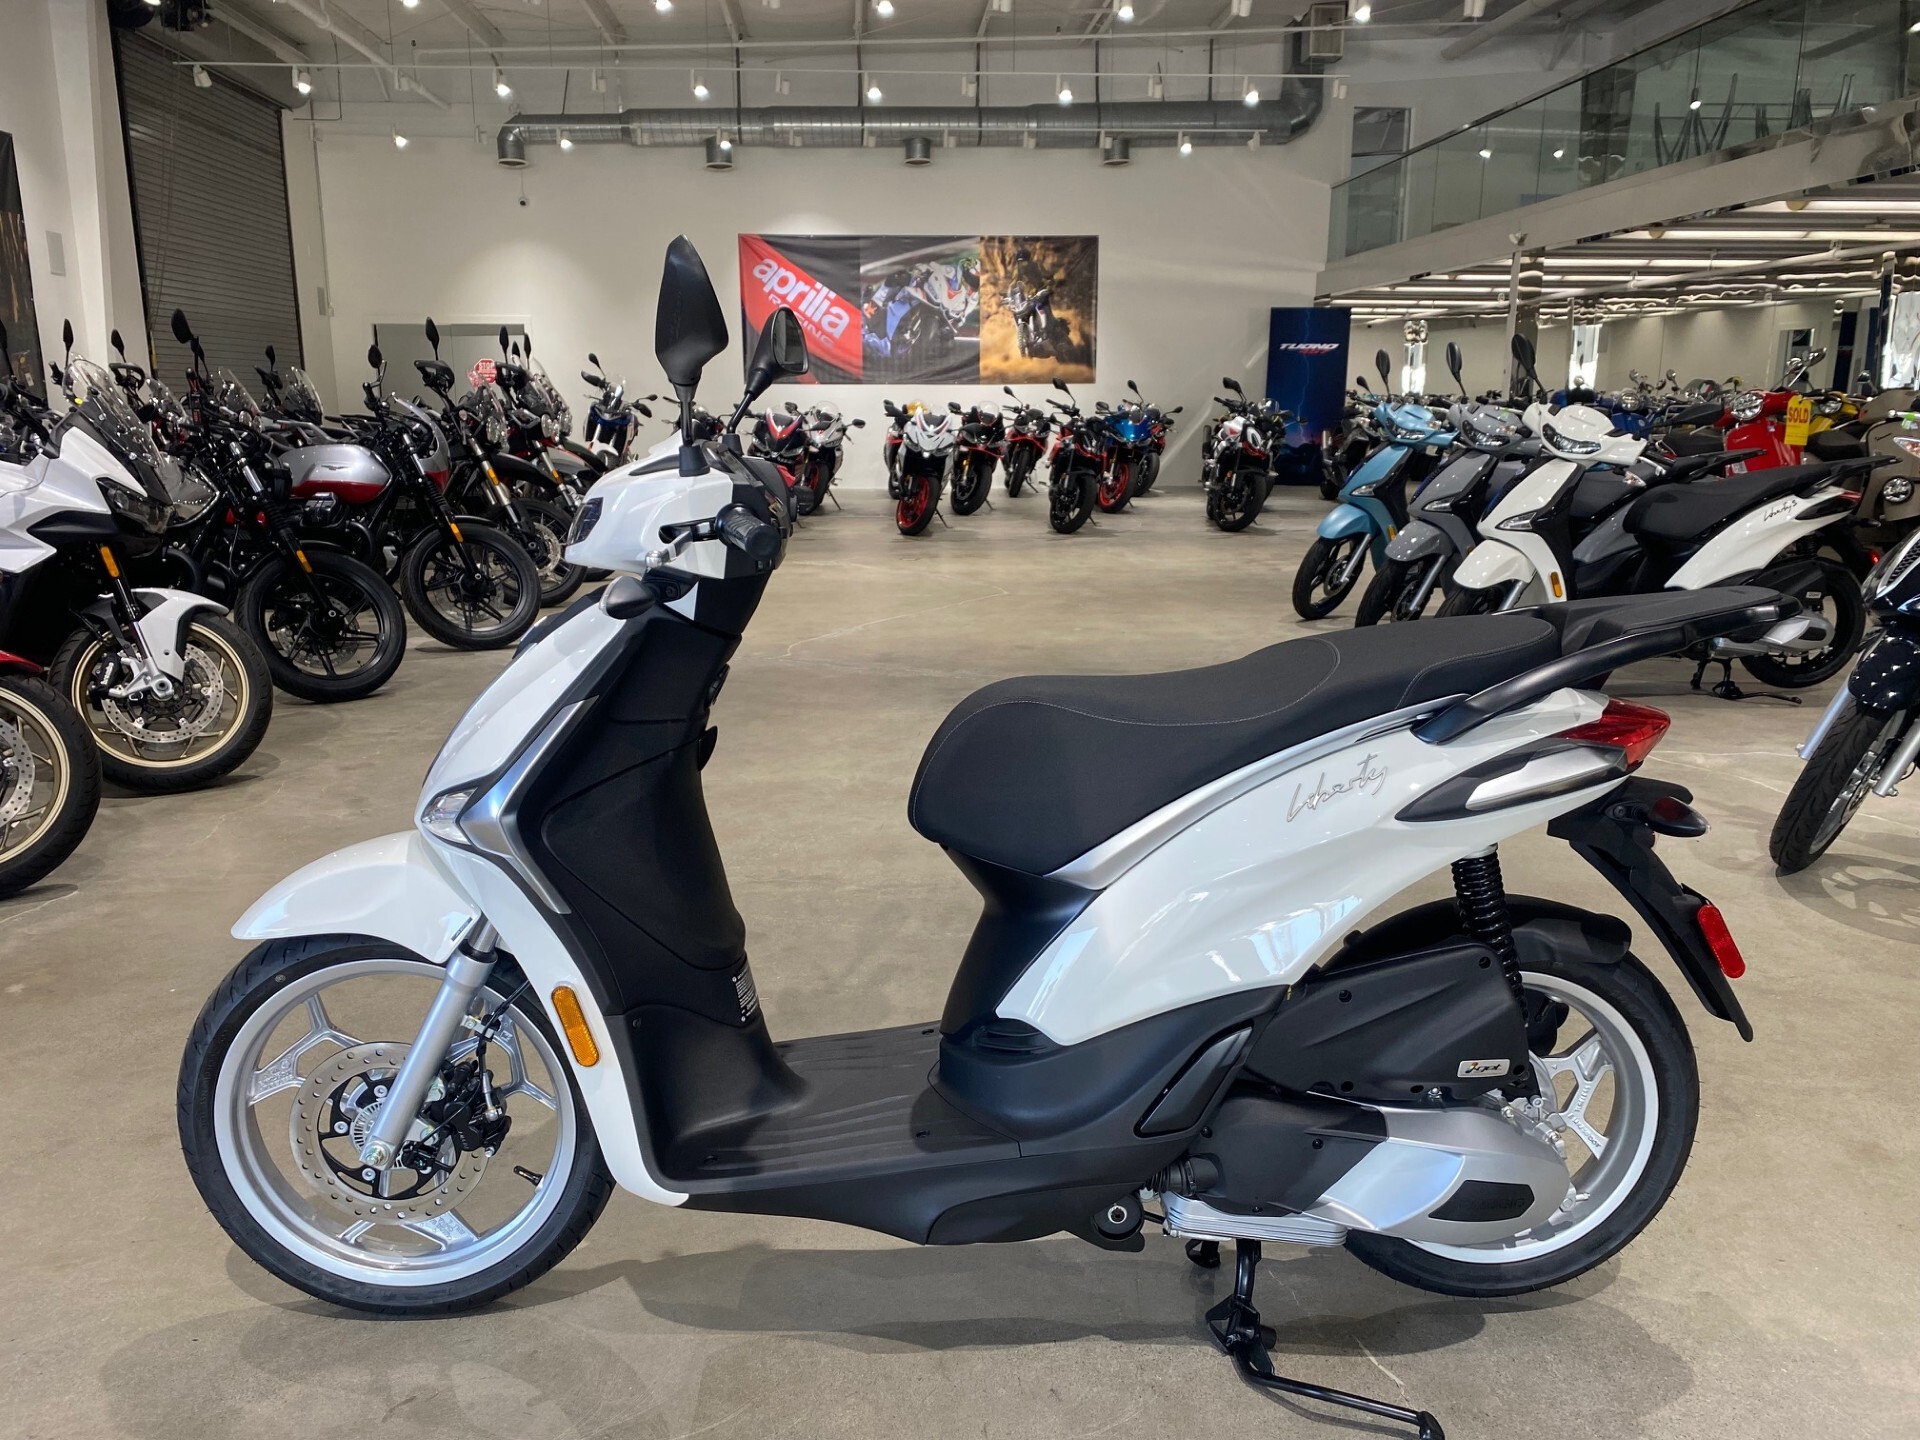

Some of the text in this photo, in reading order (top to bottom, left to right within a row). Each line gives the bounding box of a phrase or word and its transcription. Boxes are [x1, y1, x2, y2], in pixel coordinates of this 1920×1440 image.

[753, 258, 850, 339] aprilia
[1788, 407, 1809, 424] SOLD
[1286, 753, 1388, 823] Liberty
